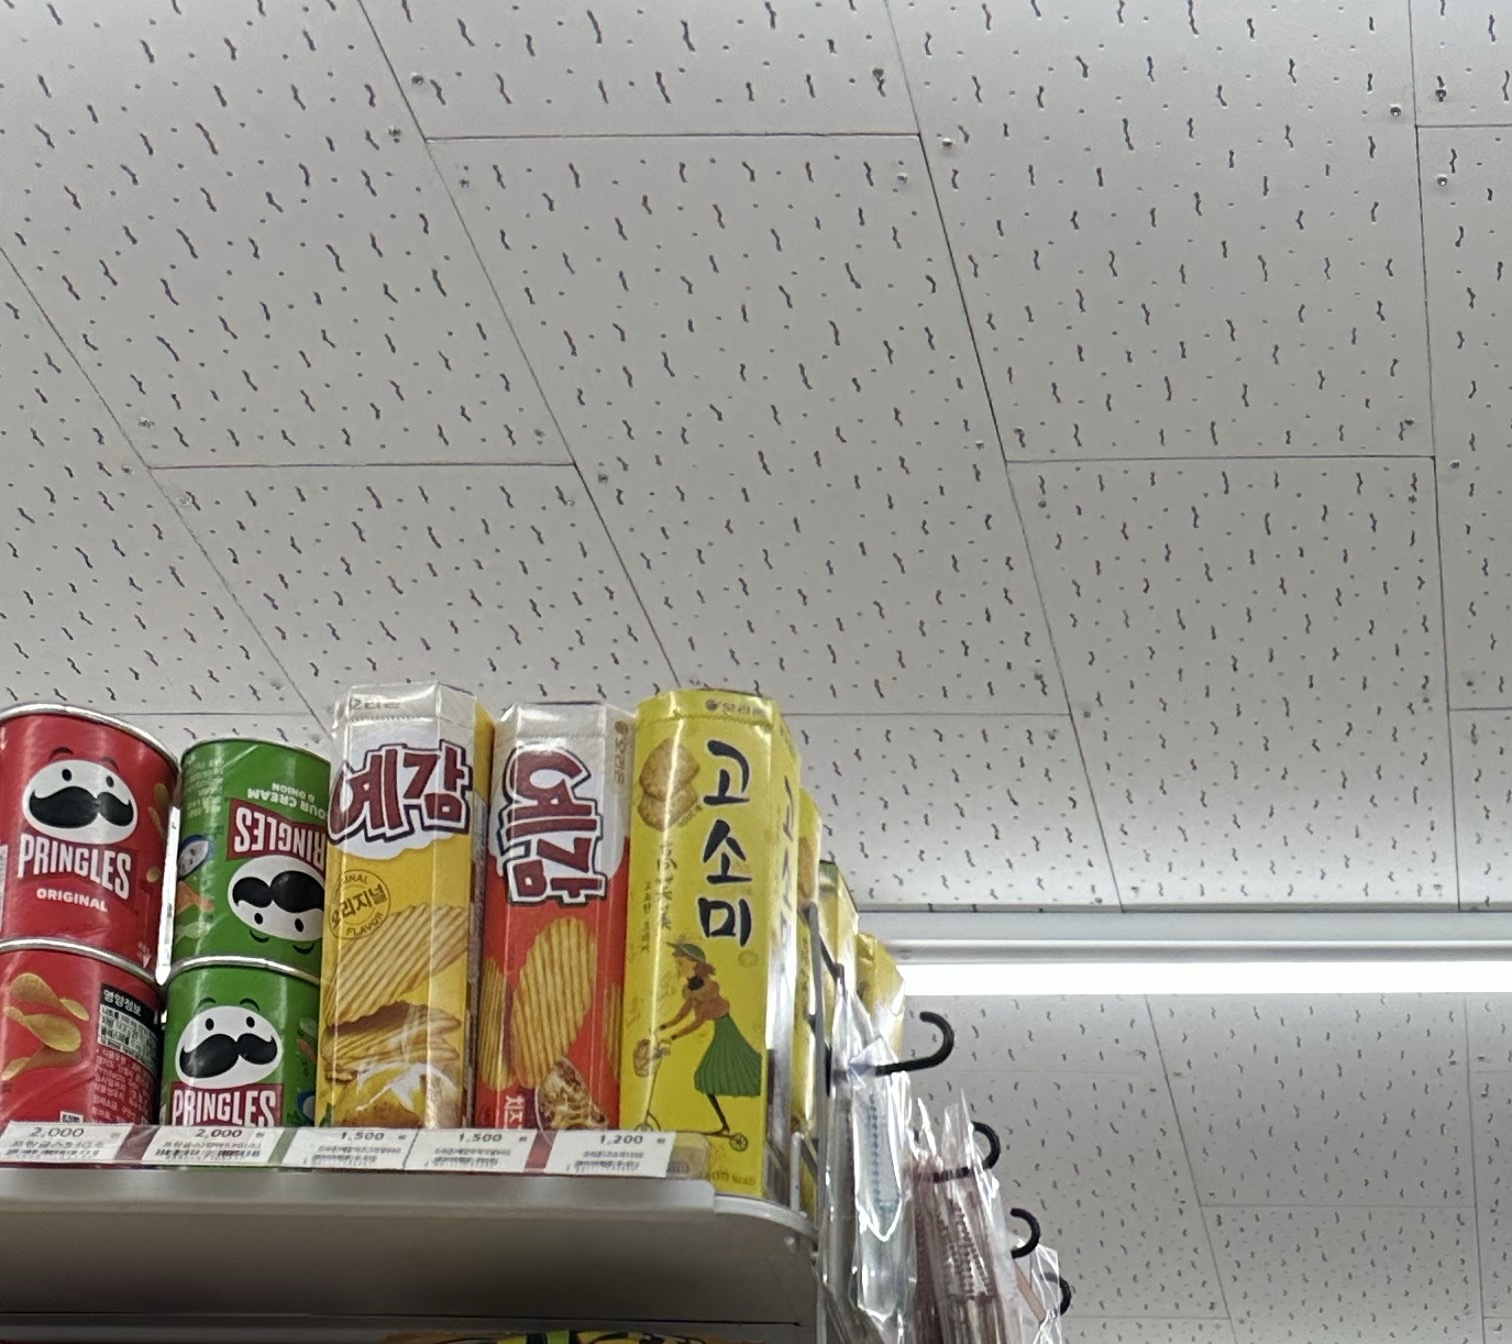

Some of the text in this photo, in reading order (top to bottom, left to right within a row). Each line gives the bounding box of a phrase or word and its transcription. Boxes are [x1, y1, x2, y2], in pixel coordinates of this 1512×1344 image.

[247, 786, 328, 821] OUR CREAM
[330, 744, 471, 842] 예감
[234, 806, 328, 873] RINGLES
[503, 745, 607, 906] 예감
[697, 739, 753, 948] 고소미
[18, 831, 133, 901] PRINGLES
[36, 887, 109, 914] ORIGINAL
[31, 1127, 85, 1139] 2,000
[171, 1087, 279, 1127] PRINGLES
[196, 1128, 243, 1140] 2,000
